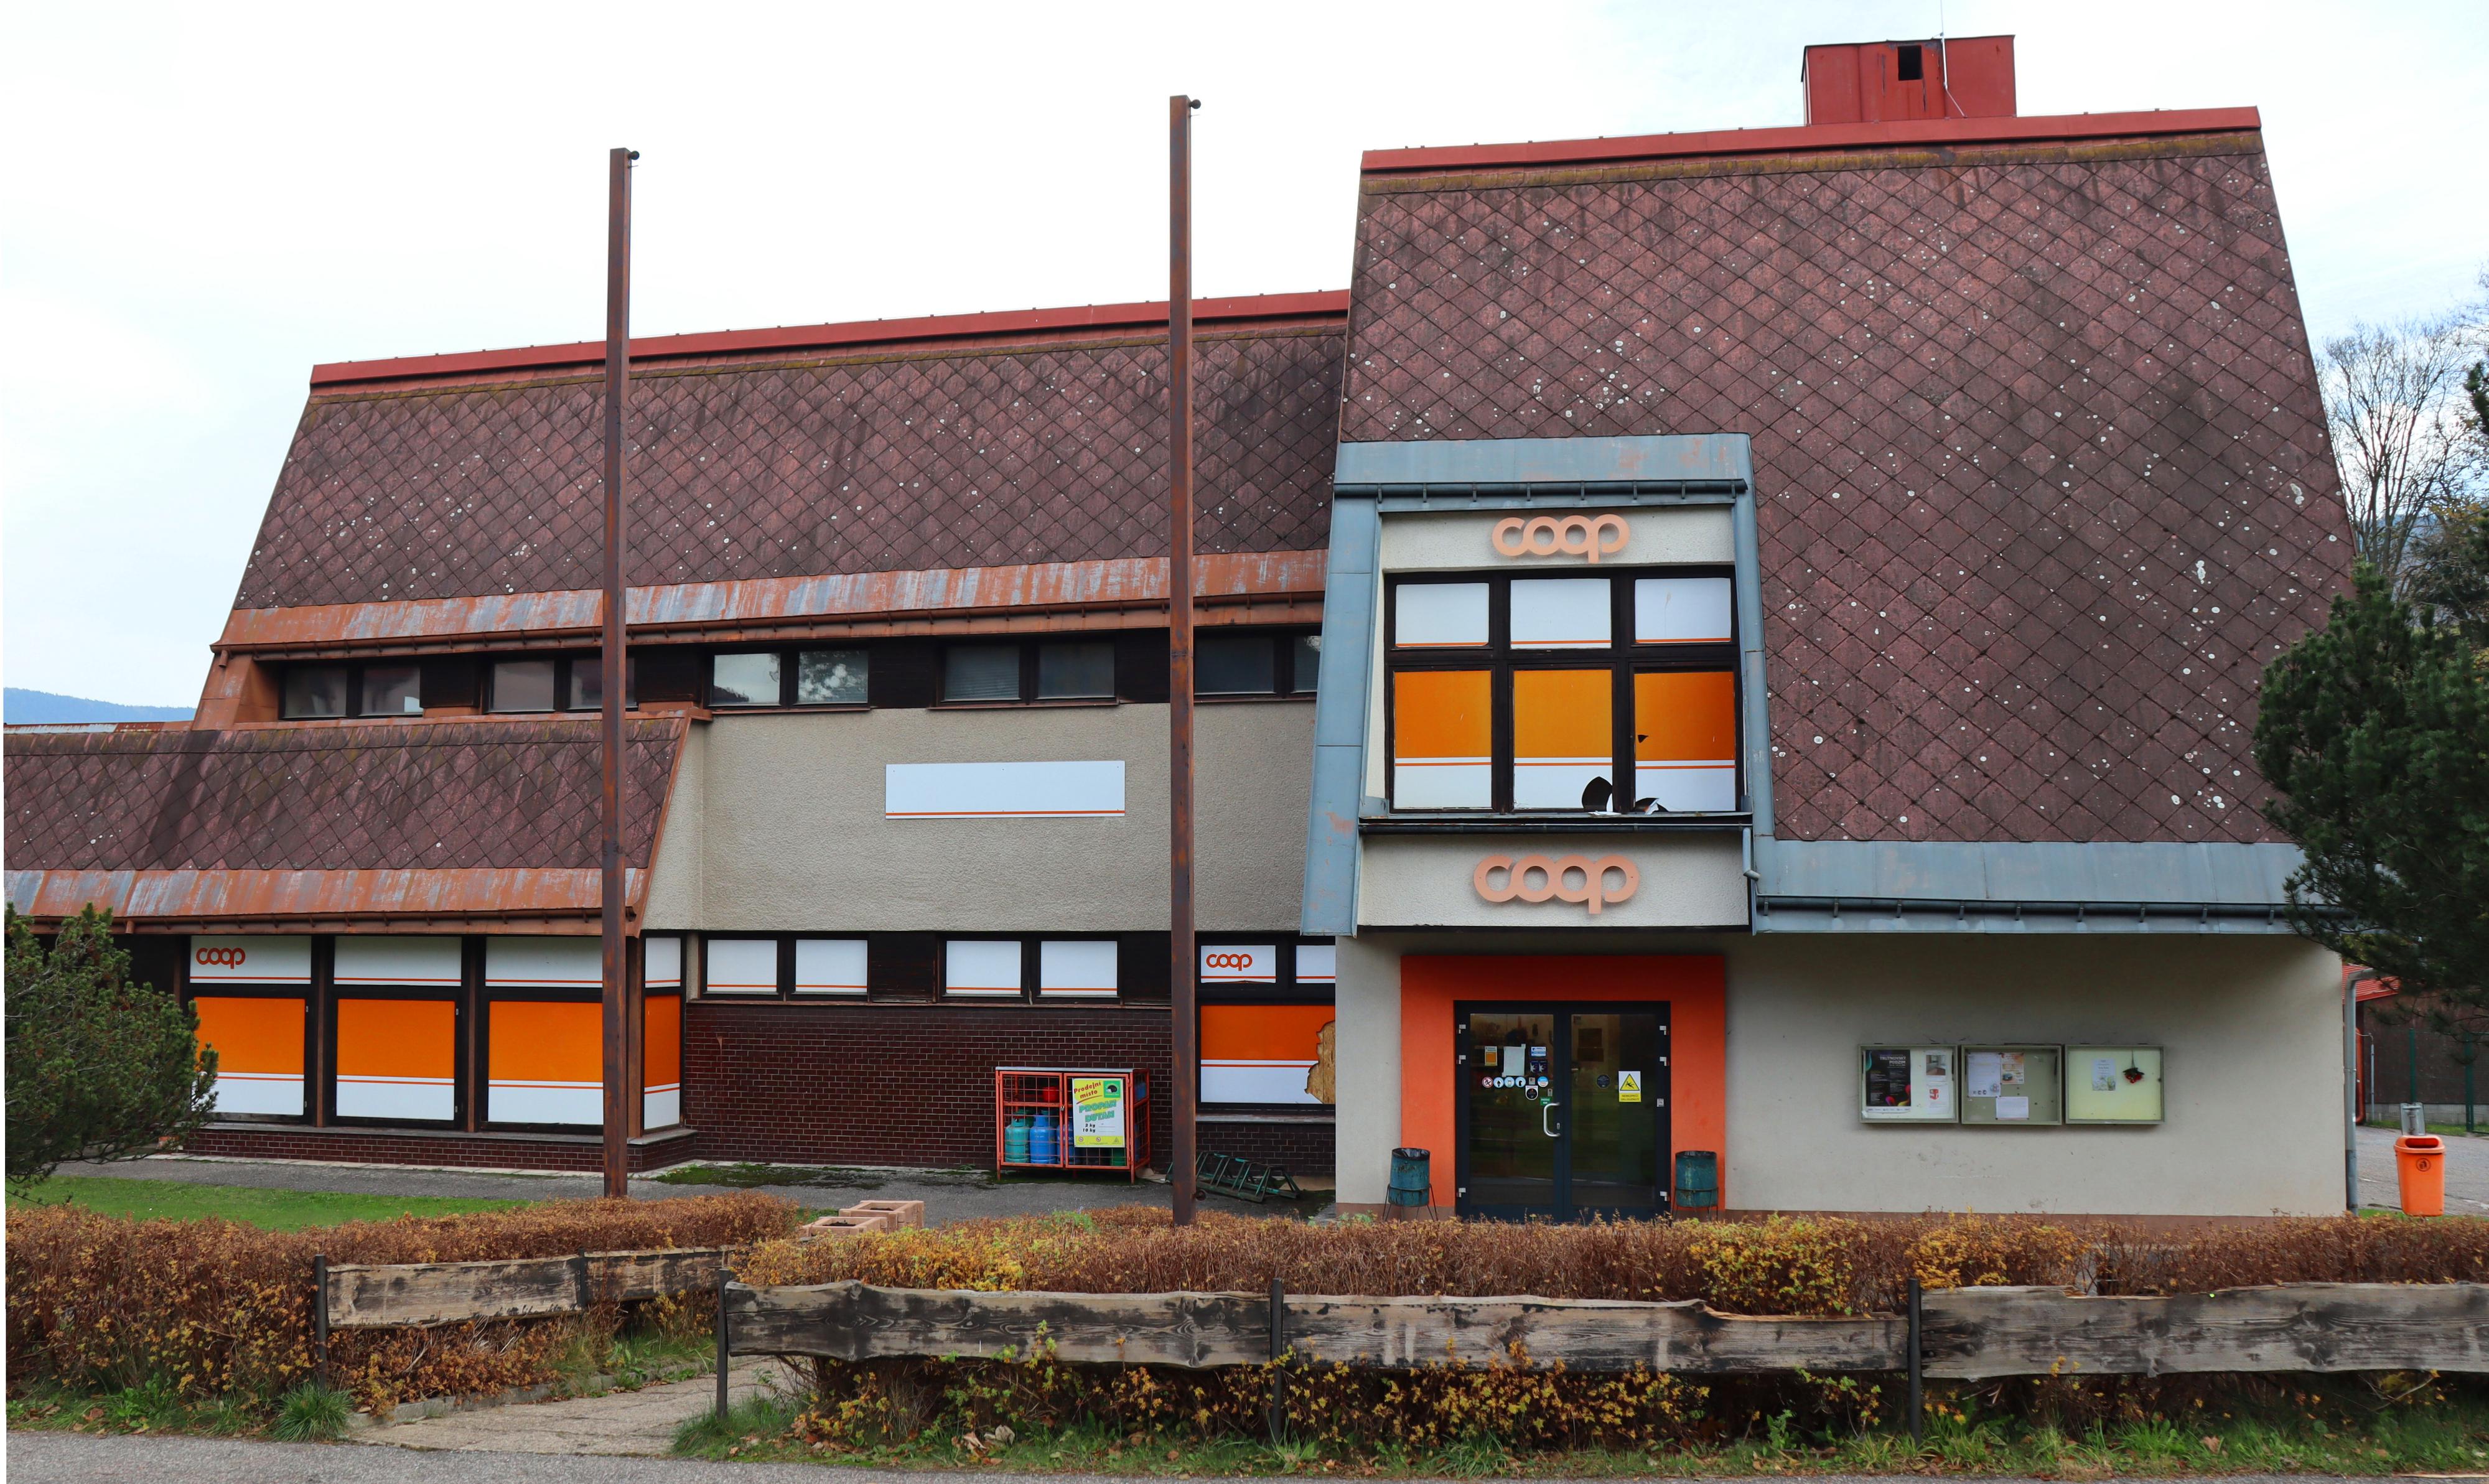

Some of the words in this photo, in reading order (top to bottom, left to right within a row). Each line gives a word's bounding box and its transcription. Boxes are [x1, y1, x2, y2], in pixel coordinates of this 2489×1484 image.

[1492, 513, 1631, 564] coop
[1473, 854, 1640, 915] coop
[195, 947, 246, 969] coop
[1206, 953, 1253, 971] coop
